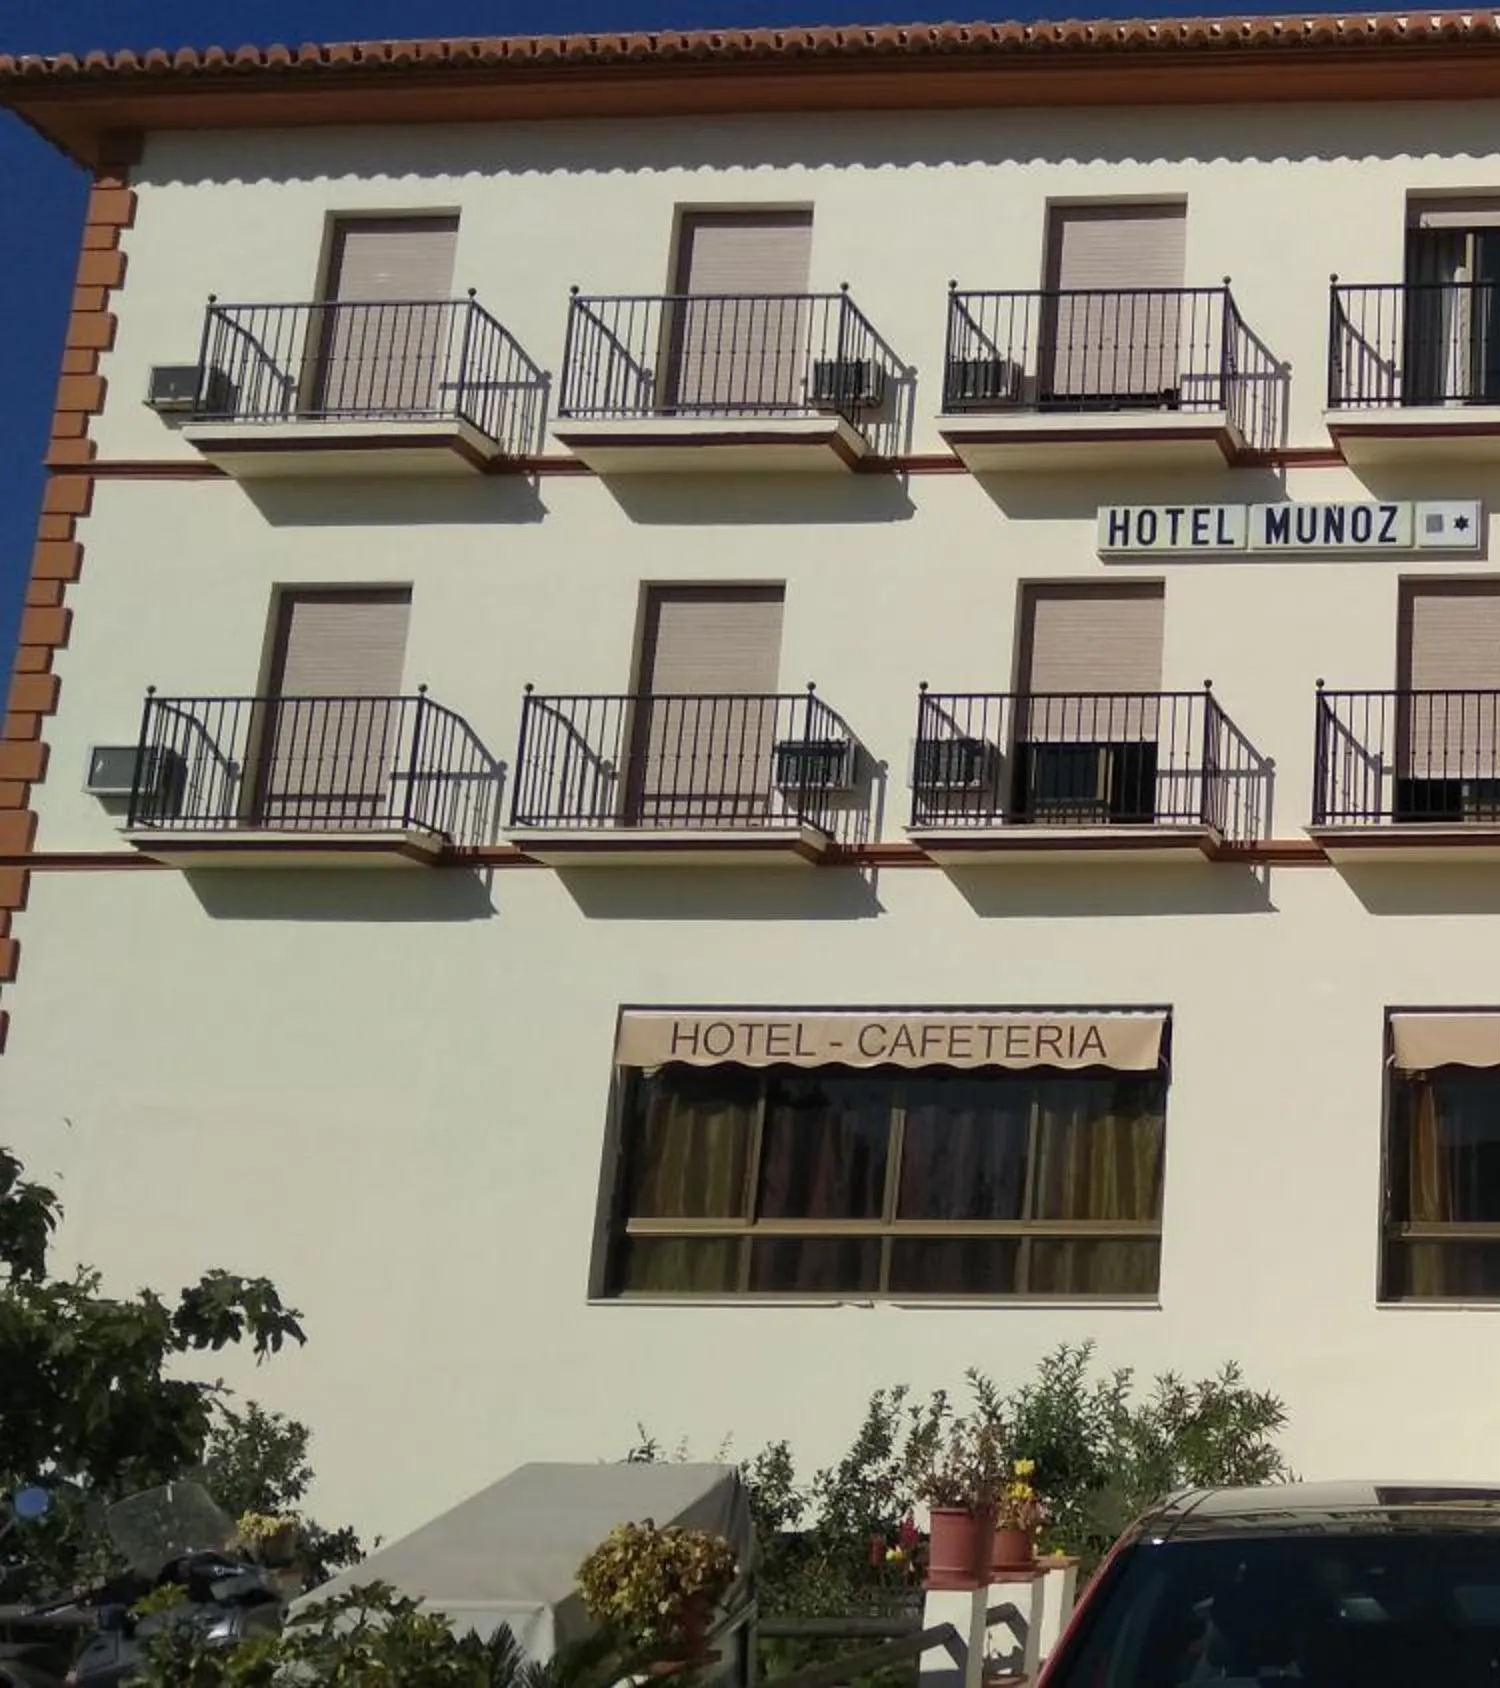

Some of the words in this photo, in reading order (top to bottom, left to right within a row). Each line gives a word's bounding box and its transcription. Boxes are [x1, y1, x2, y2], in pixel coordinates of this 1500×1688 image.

[1108, 508, 1235, 547] HOTEL
[1264, 504, 1399, 545] MUÑOZ
[669, 1021, 817, 1058] HOTEL
[857, 1023, 1108, 1059] CAFETERIA
